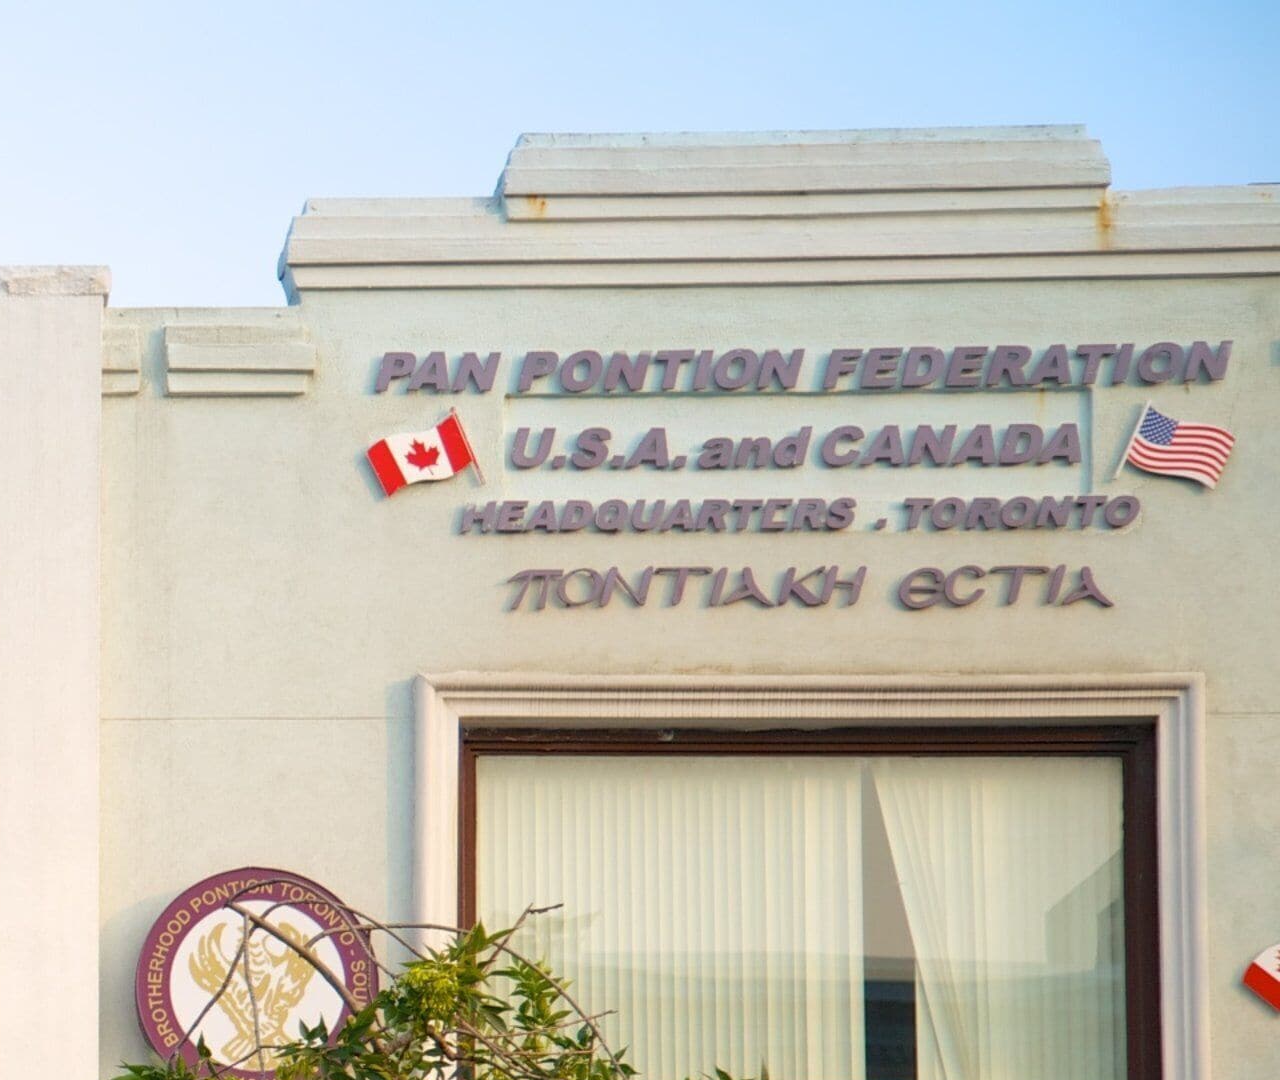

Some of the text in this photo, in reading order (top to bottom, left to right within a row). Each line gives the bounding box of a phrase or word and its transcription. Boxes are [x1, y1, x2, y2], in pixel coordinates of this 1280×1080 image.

[375, 340, 1234, 393] PAN PONTION FEDERATION
[510, 422, 1082, 470] U.S.A. and CANADA
[459, 498, 857, 534] HEADQUARTERS
[904, 494, 1141, 530] TORONTO
[147, 909, 191, 1048] BROTHERHOOD
[280, 882, 356, 946] TORONTO
